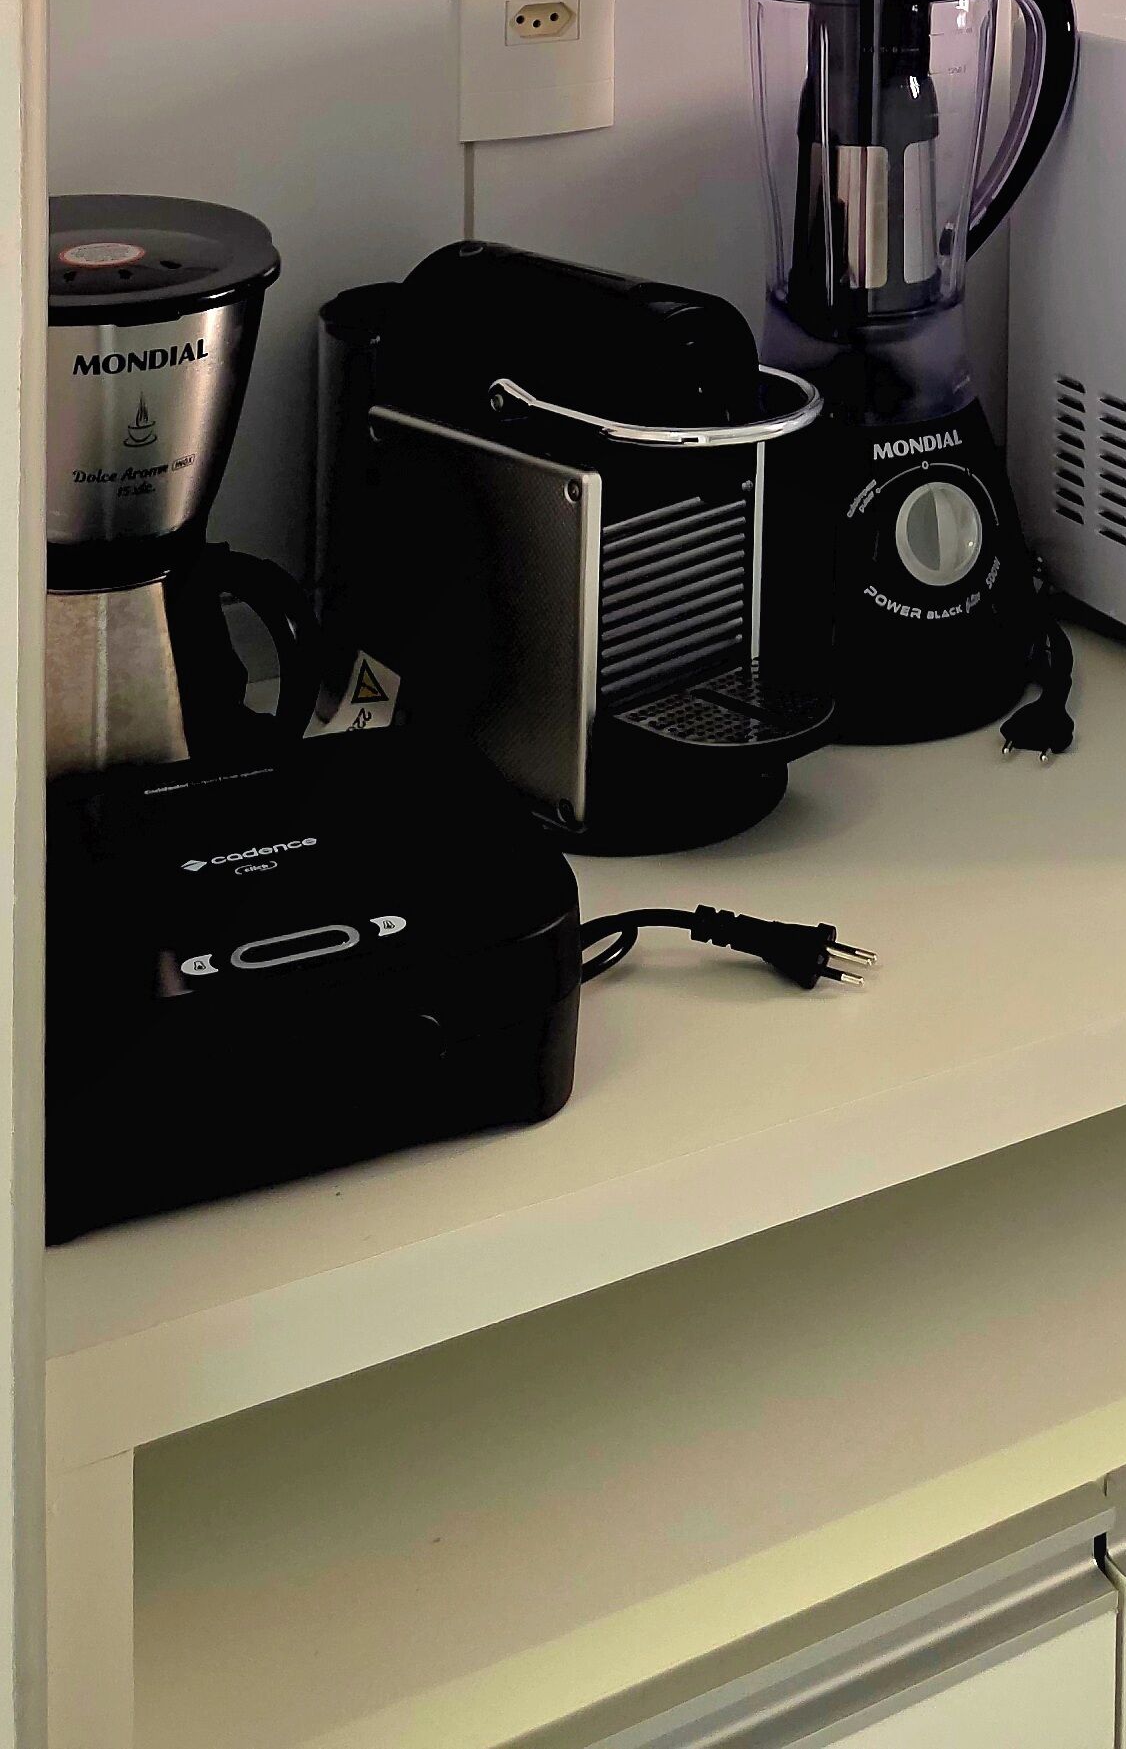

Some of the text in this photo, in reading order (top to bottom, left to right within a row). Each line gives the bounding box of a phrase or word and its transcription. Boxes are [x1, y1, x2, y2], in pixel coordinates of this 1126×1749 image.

[73, 338, 209, 376] MONDIAL
[873, 429, 963, 461] MONDIAL
[72, 468, 118, 484] Dolce
[863, 585, 963, 620] POWER BLACK
[211, 837, 317, 865] cadence
